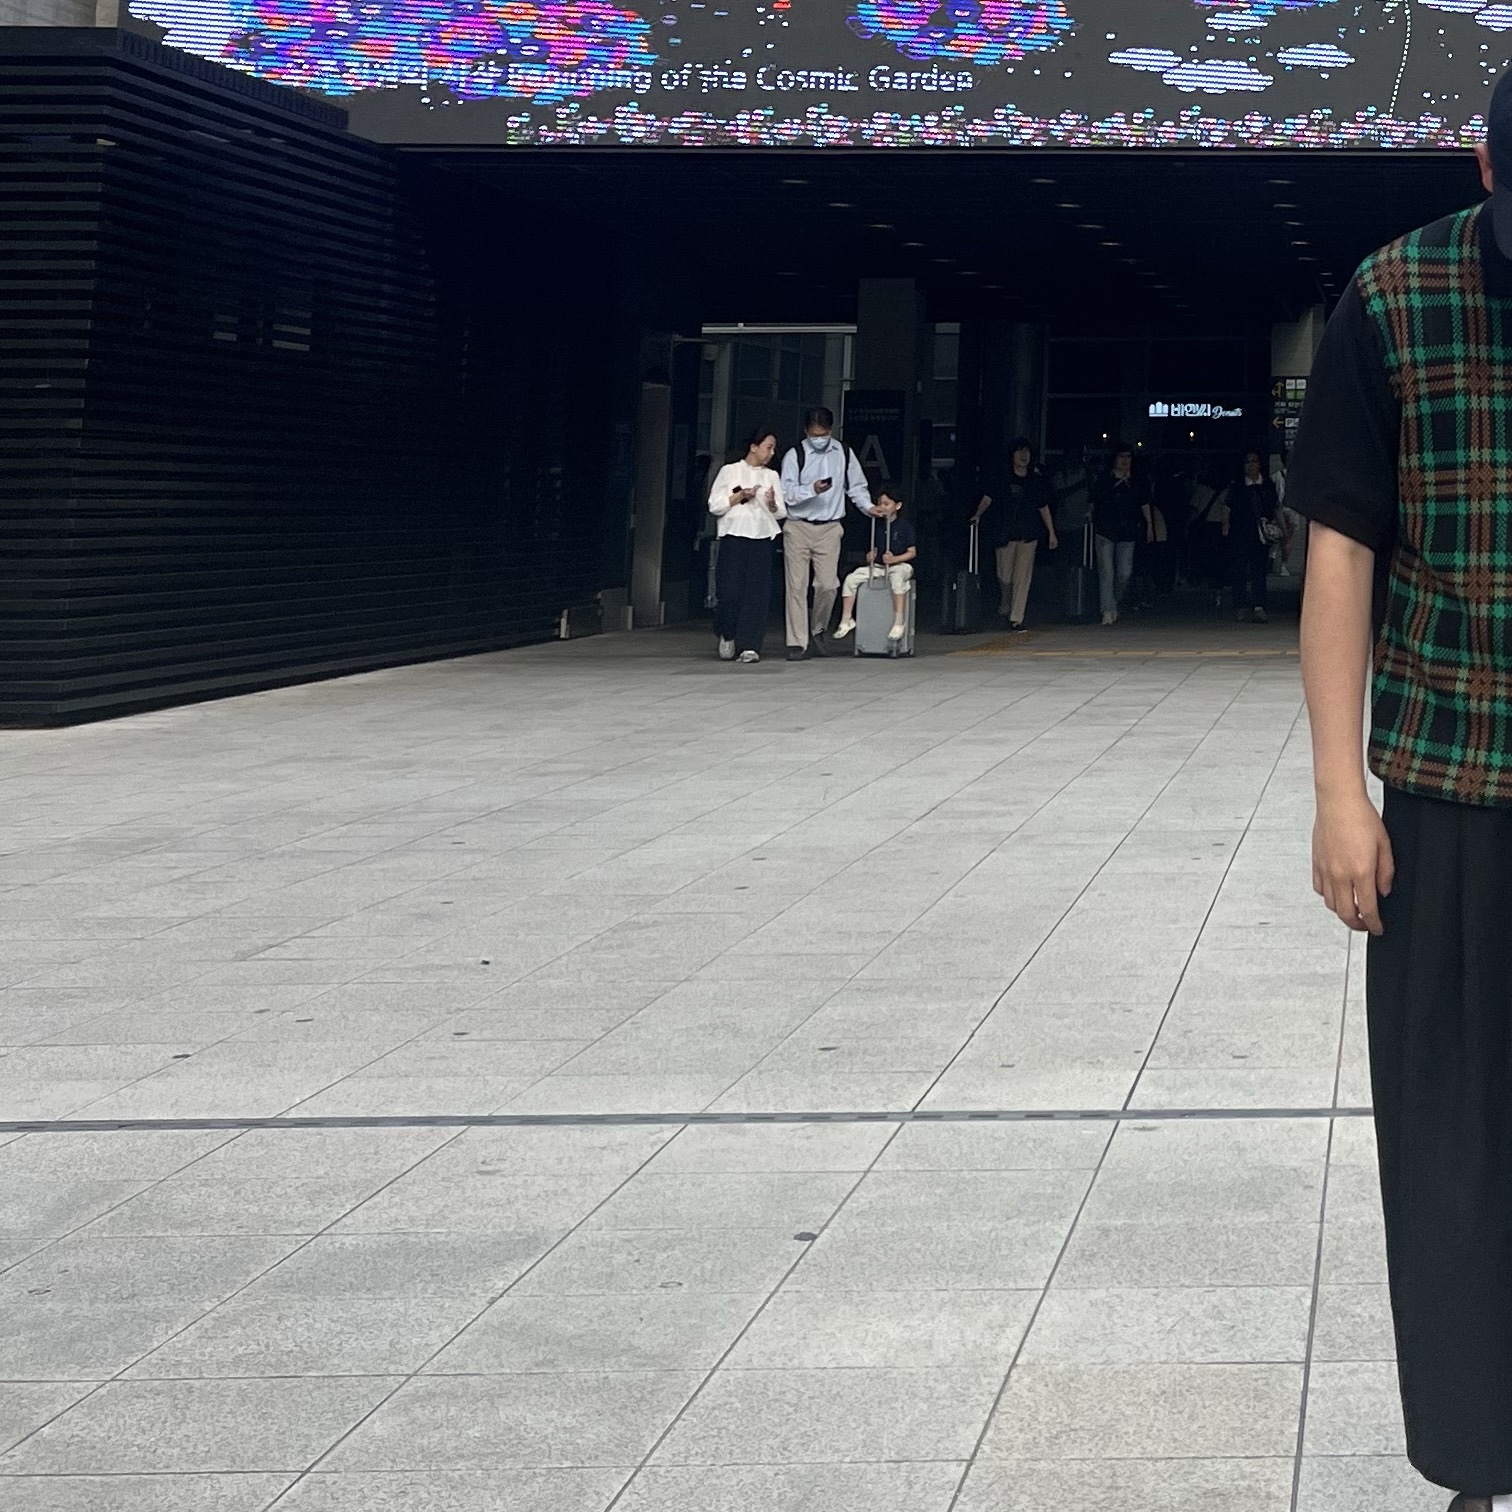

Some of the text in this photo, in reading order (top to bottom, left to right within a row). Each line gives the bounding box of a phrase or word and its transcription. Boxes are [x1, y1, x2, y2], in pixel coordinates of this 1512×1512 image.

[756, 64, 859, 92] Cosmic
[868, 63, 974, 92] Garden
[860, 434, 891, 480] A
